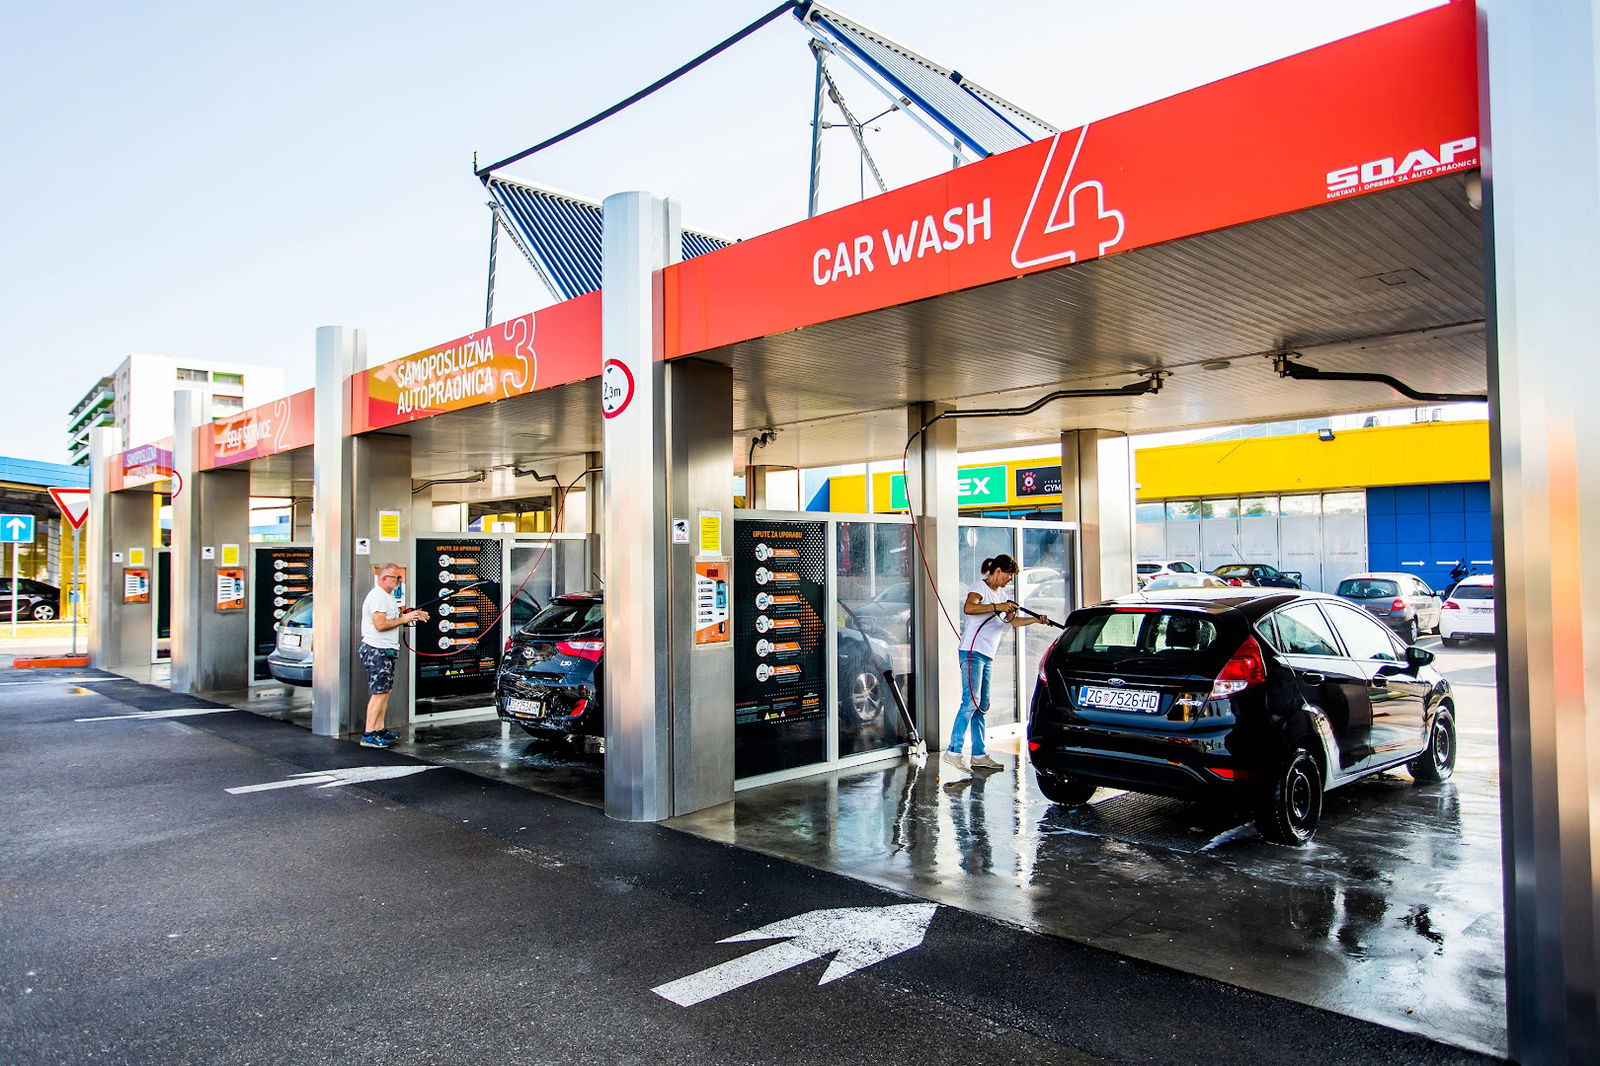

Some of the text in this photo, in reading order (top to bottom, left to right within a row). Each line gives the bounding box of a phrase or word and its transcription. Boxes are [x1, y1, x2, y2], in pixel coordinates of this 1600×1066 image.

[1326, 137, 1476, 191] SOAP
[1326, 187, 1356, 199] SUSTAVI
[1364, 178, 1395, 190] OPREMA
[1411, 170, 1433, 179] AUTO
[1436, 158, 1477, 173] PRAONICE
[813, 198, 991, 286] CAR WASH
[397, 334, 495, 389] SAMOPOSLUŽNA
[504, 312, 538, 398] 3
[396, 366, 495, 415] AUTOPRAONICA
[752, 530, 770, 538] UPUTE
[771, 530, 779, 538] ZA
[1087, 689, 1103, 704] ZG
